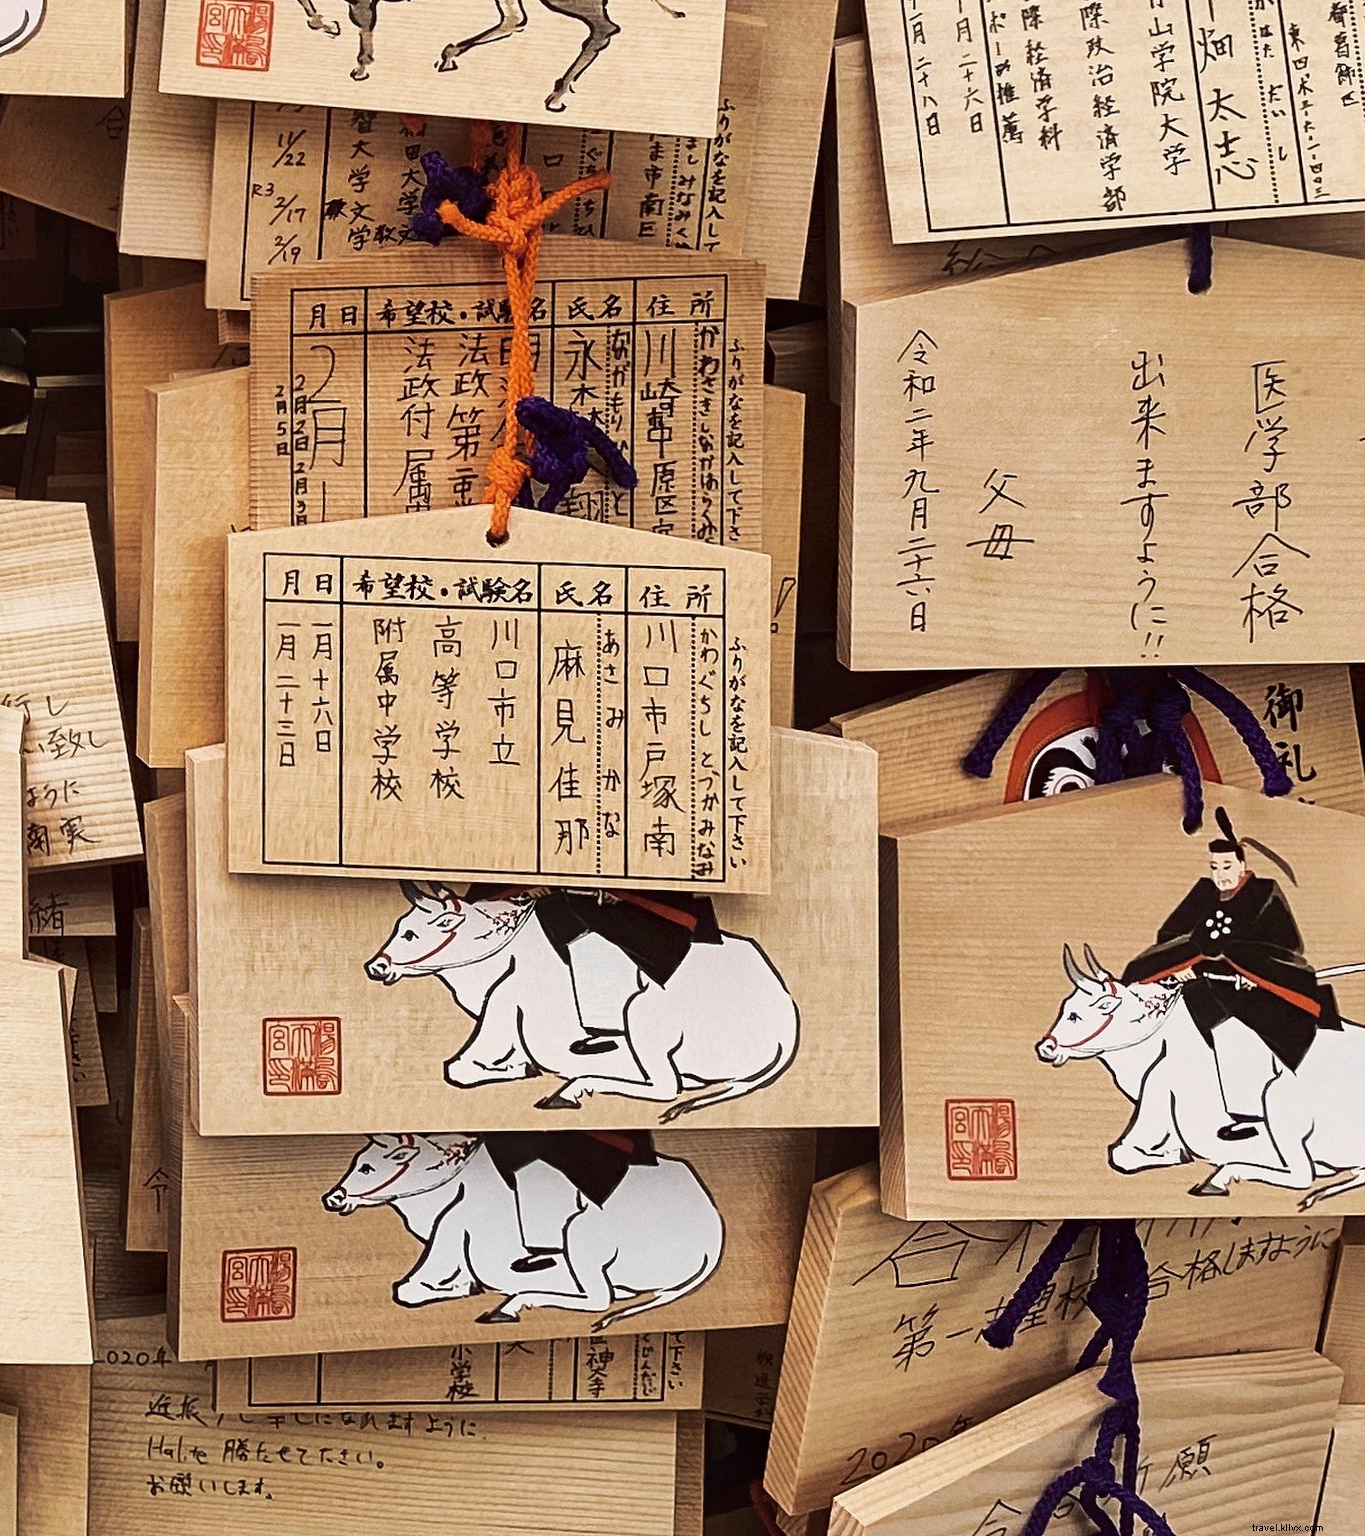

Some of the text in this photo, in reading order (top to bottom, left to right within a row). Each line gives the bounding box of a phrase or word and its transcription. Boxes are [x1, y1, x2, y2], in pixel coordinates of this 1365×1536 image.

[566, 296, 622, 320] 氏名
[646, 292, 715, 315] 住所
[896, 330, 939, 632] 令和二年九月二十六日
[967, 469, 1034, 560] 父母
[1232, 360, 1311, 643] 医学部合格
[282, 570, 333, 595] 月日
[554, 586, 613, 607] 氏名
[641, 584, 710, 610] 住所
[429, 616, 465, 801] 高等学校
[489, 618, 522, 767] 川口市立
[641, 621, 685, 859] 川口市戸塚南
[727, 637, 748, 868] ふりがなを記入して下さい
